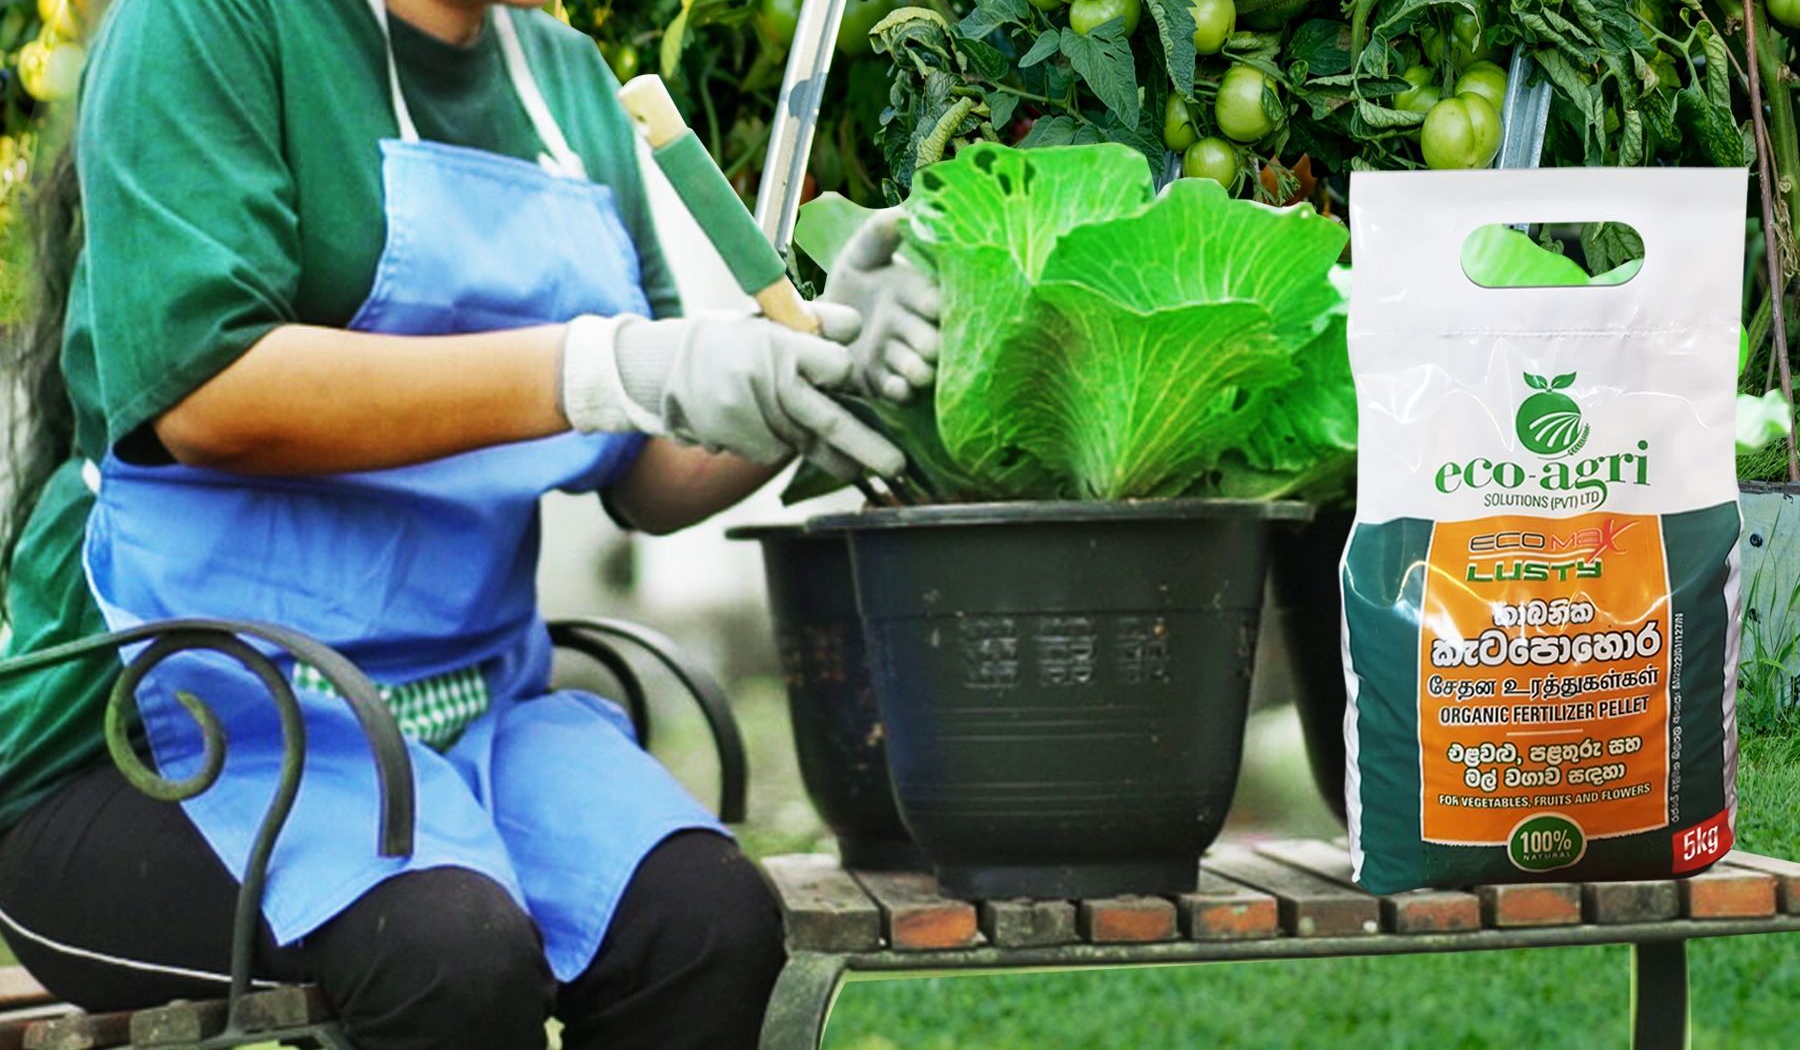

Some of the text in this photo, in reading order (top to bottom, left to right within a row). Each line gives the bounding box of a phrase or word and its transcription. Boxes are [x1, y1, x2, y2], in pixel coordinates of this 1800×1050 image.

[1435, 439, 1650, 511] eco-agri
[1484, 491, 1599, 510] SOLUTIONS (PVT) LTD
[1467, 558, 1602, 582] LUSTY
[1491, 598, 1595, 629] කාබනික
[1431, 620, 1662, 668] කැටපොහොර
[1429, 664, 1659, 700] சேதன உரத்துகள்கள்
[1440, 695, 1650, 725] ORGANIC FERTILIZER PELLET
[1529, 738, 1602, 765] පළතුරු
[1608, 735, 1642, 755] සහ
[1464, 767, 1497, 792] මල්
[1504, 765, 1561, 787] වගාව
[1438, 795, 1459, 806] FOR
[1534, 794, 1572, 806] FRUITS
[1575, 792, 1599, 804] AND
[1601, 784, 1651, 801] FLOWERS
[1520, 830, 1572, 854] 100%
[1523, 852, 1571, 861] NATURAL
[1683, 824, 1719, 861] 5kg
